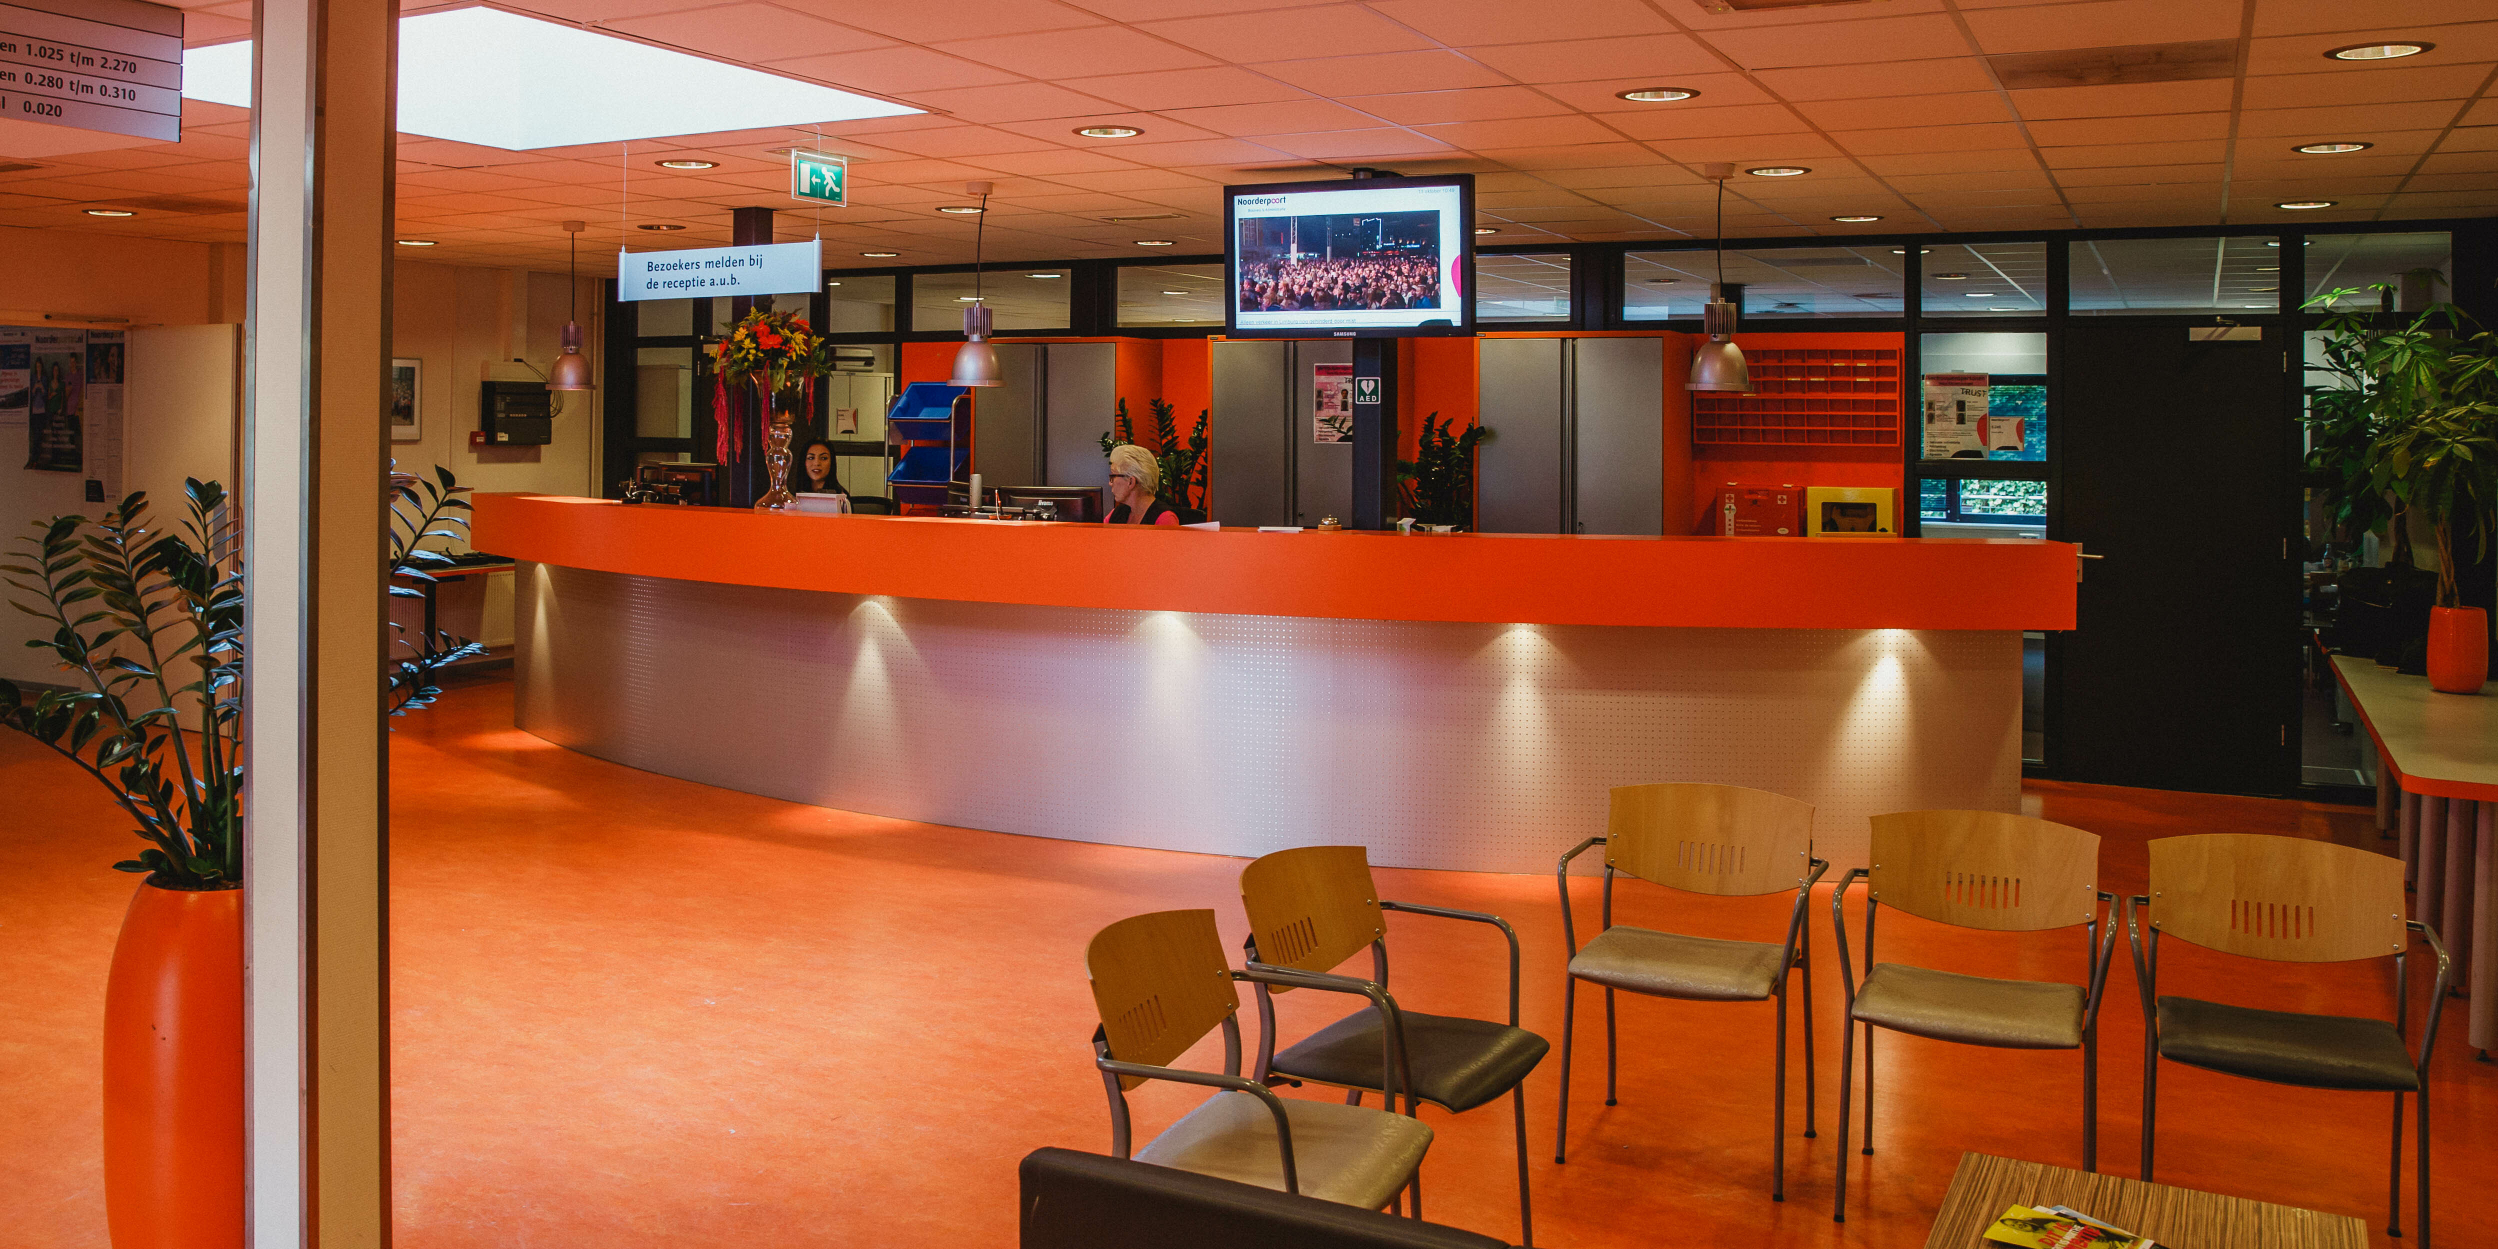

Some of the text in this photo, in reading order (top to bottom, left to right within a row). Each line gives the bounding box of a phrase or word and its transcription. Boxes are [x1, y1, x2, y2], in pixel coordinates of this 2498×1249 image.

[25, 43, 64, 61] 1.025
[70, 51, 94, 67] t/m
[100, 56, 137, 74] 2.270
[24, 72, 64, 90] 0.280
[69, 79, 94, 95] t/m
[99, 84, 136, 102] 0.310
[23, 100, 62, 118] 0.020
[1237, 196, 1286, 206] Noorderpoort
[647, 254, 763, 272] Bezoekers melden bij
[646, 274, 740, 290] de receptie a.u.b.
[1960, 387, 1987, 398] TRUST
[2038, 1230, 2064, 1247] DIT
[2053, 1222, 2073, 1232] IS
